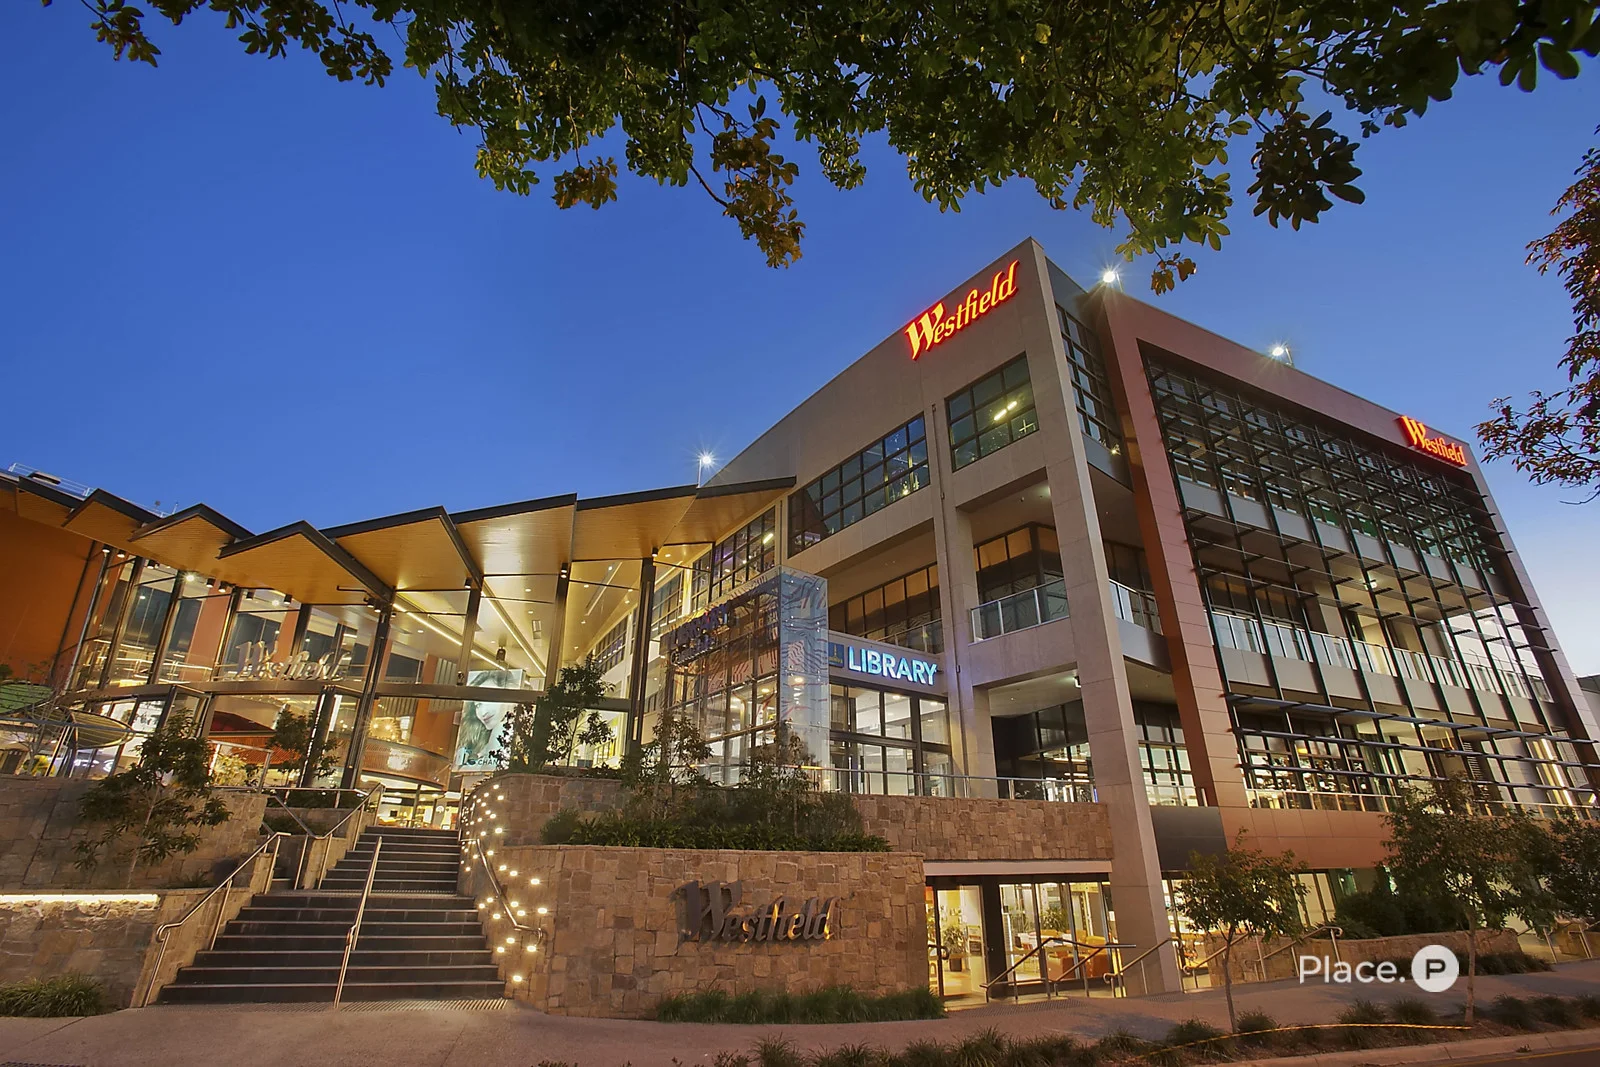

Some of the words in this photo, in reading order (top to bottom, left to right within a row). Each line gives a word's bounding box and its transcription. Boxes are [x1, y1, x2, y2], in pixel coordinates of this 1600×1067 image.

[904, 260, 1019, 360] Westfield
[1399, 415, 1468, 466] Westfield
[848, 646, 937, 685] LIBRARY
[669, 879, 842, 944] Westfield
